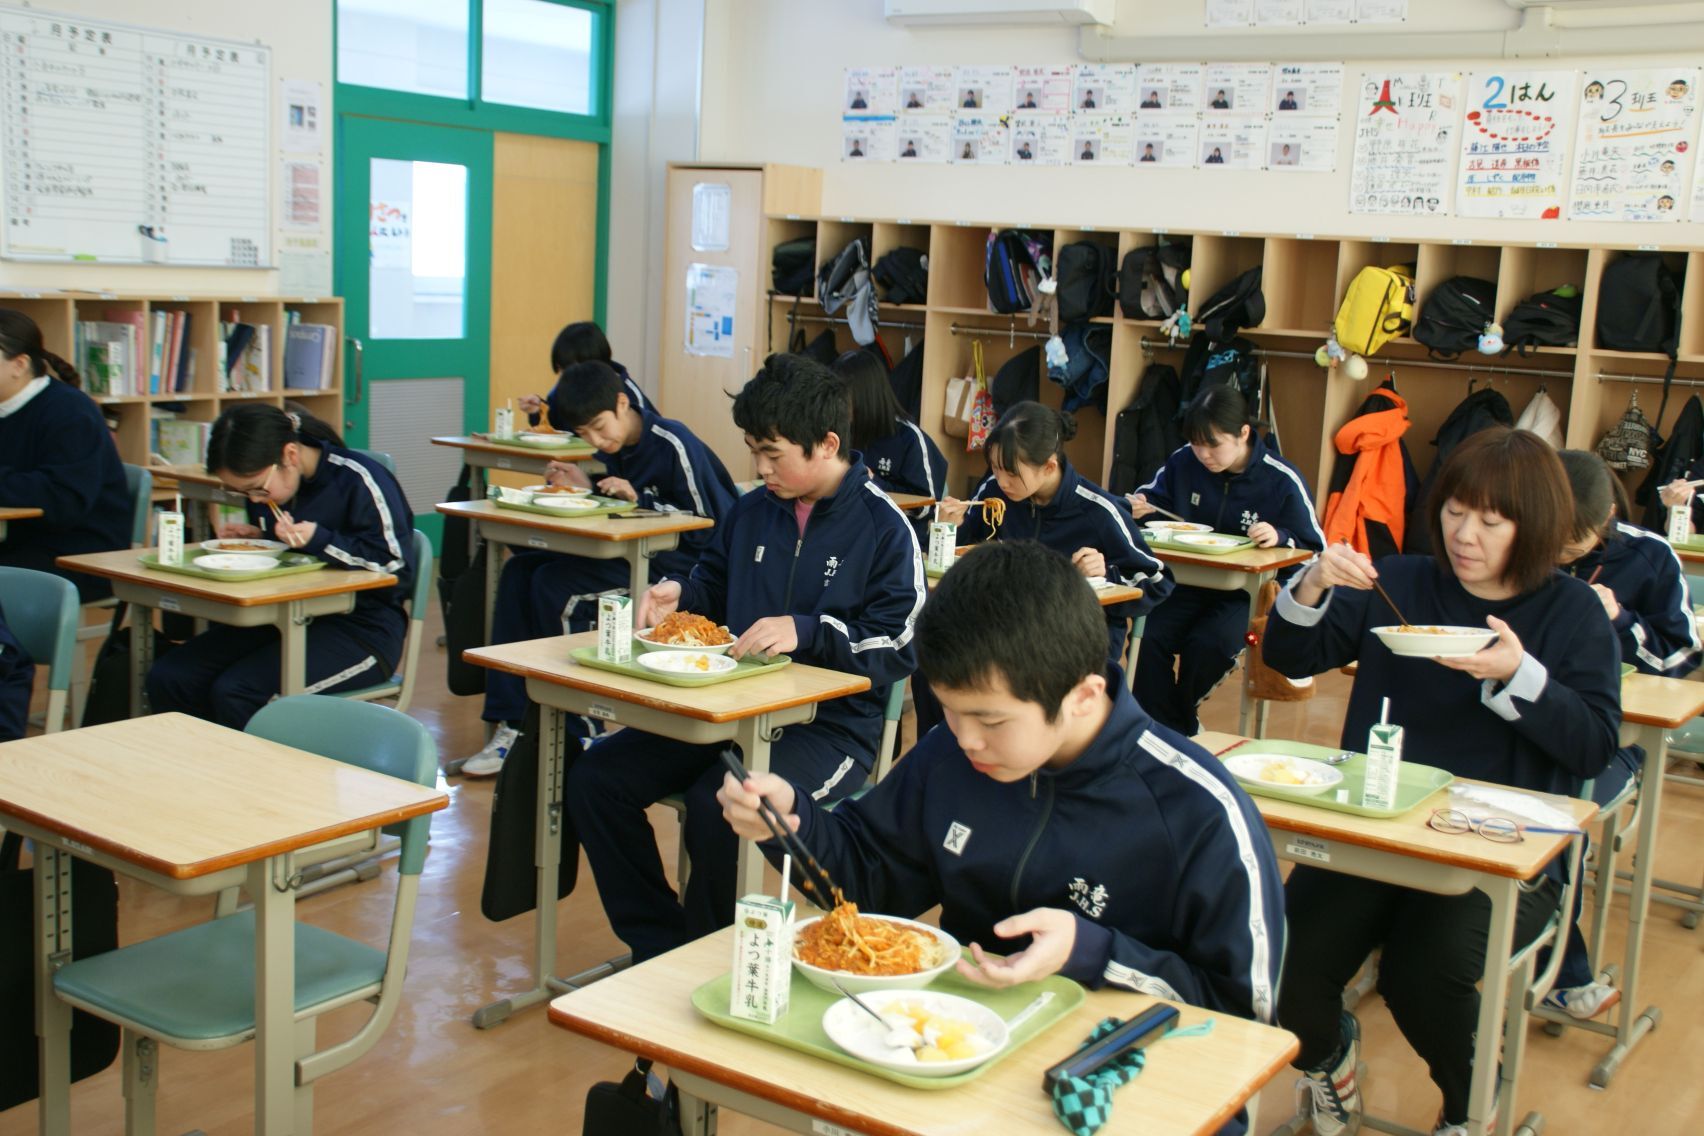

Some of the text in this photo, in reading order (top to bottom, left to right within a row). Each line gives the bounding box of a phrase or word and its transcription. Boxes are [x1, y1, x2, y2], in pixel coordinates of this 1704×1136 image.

[745, 932, 760, 1010] よつ葉牛乳
